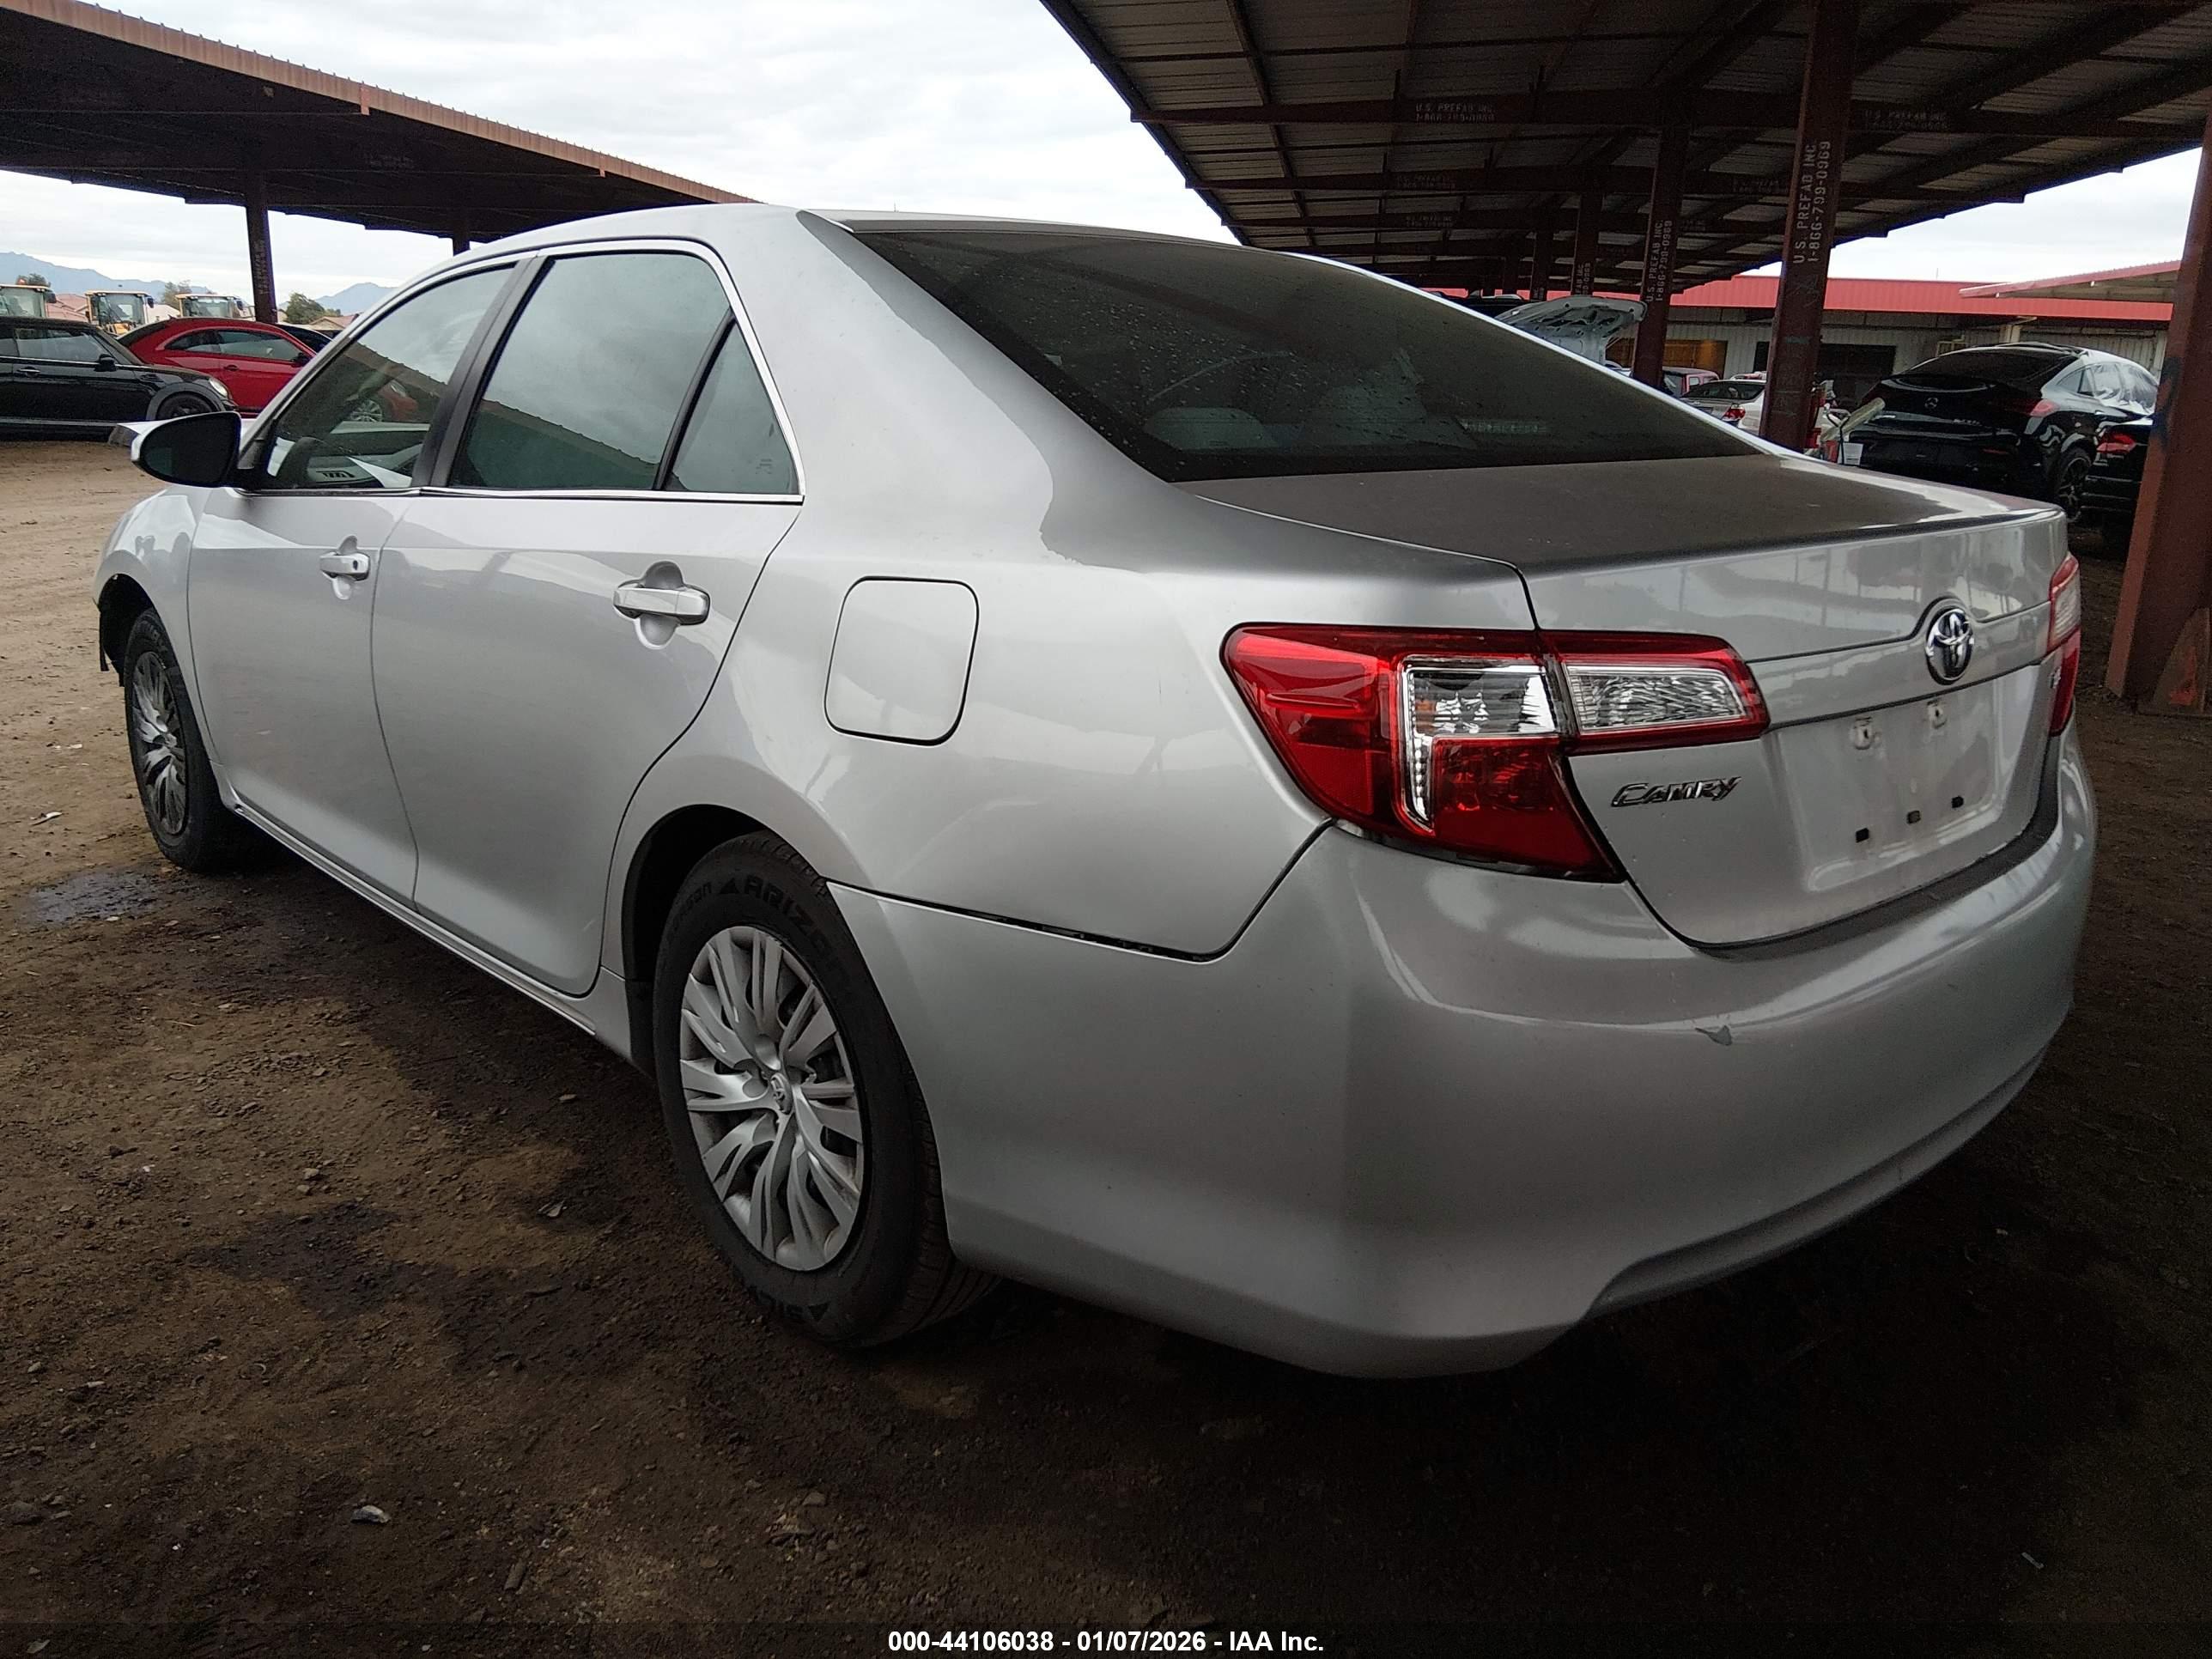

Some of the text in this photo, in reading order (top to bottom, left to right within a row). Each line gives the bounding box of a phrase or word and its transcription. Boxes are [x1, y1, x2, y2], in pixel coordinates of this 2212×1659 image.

[1796, 174, 1814, 229] PREFAB
[1807, 141, 1832, 263] 1-866-799-0969
[1649, 243, 1661, 279] PREFAB
